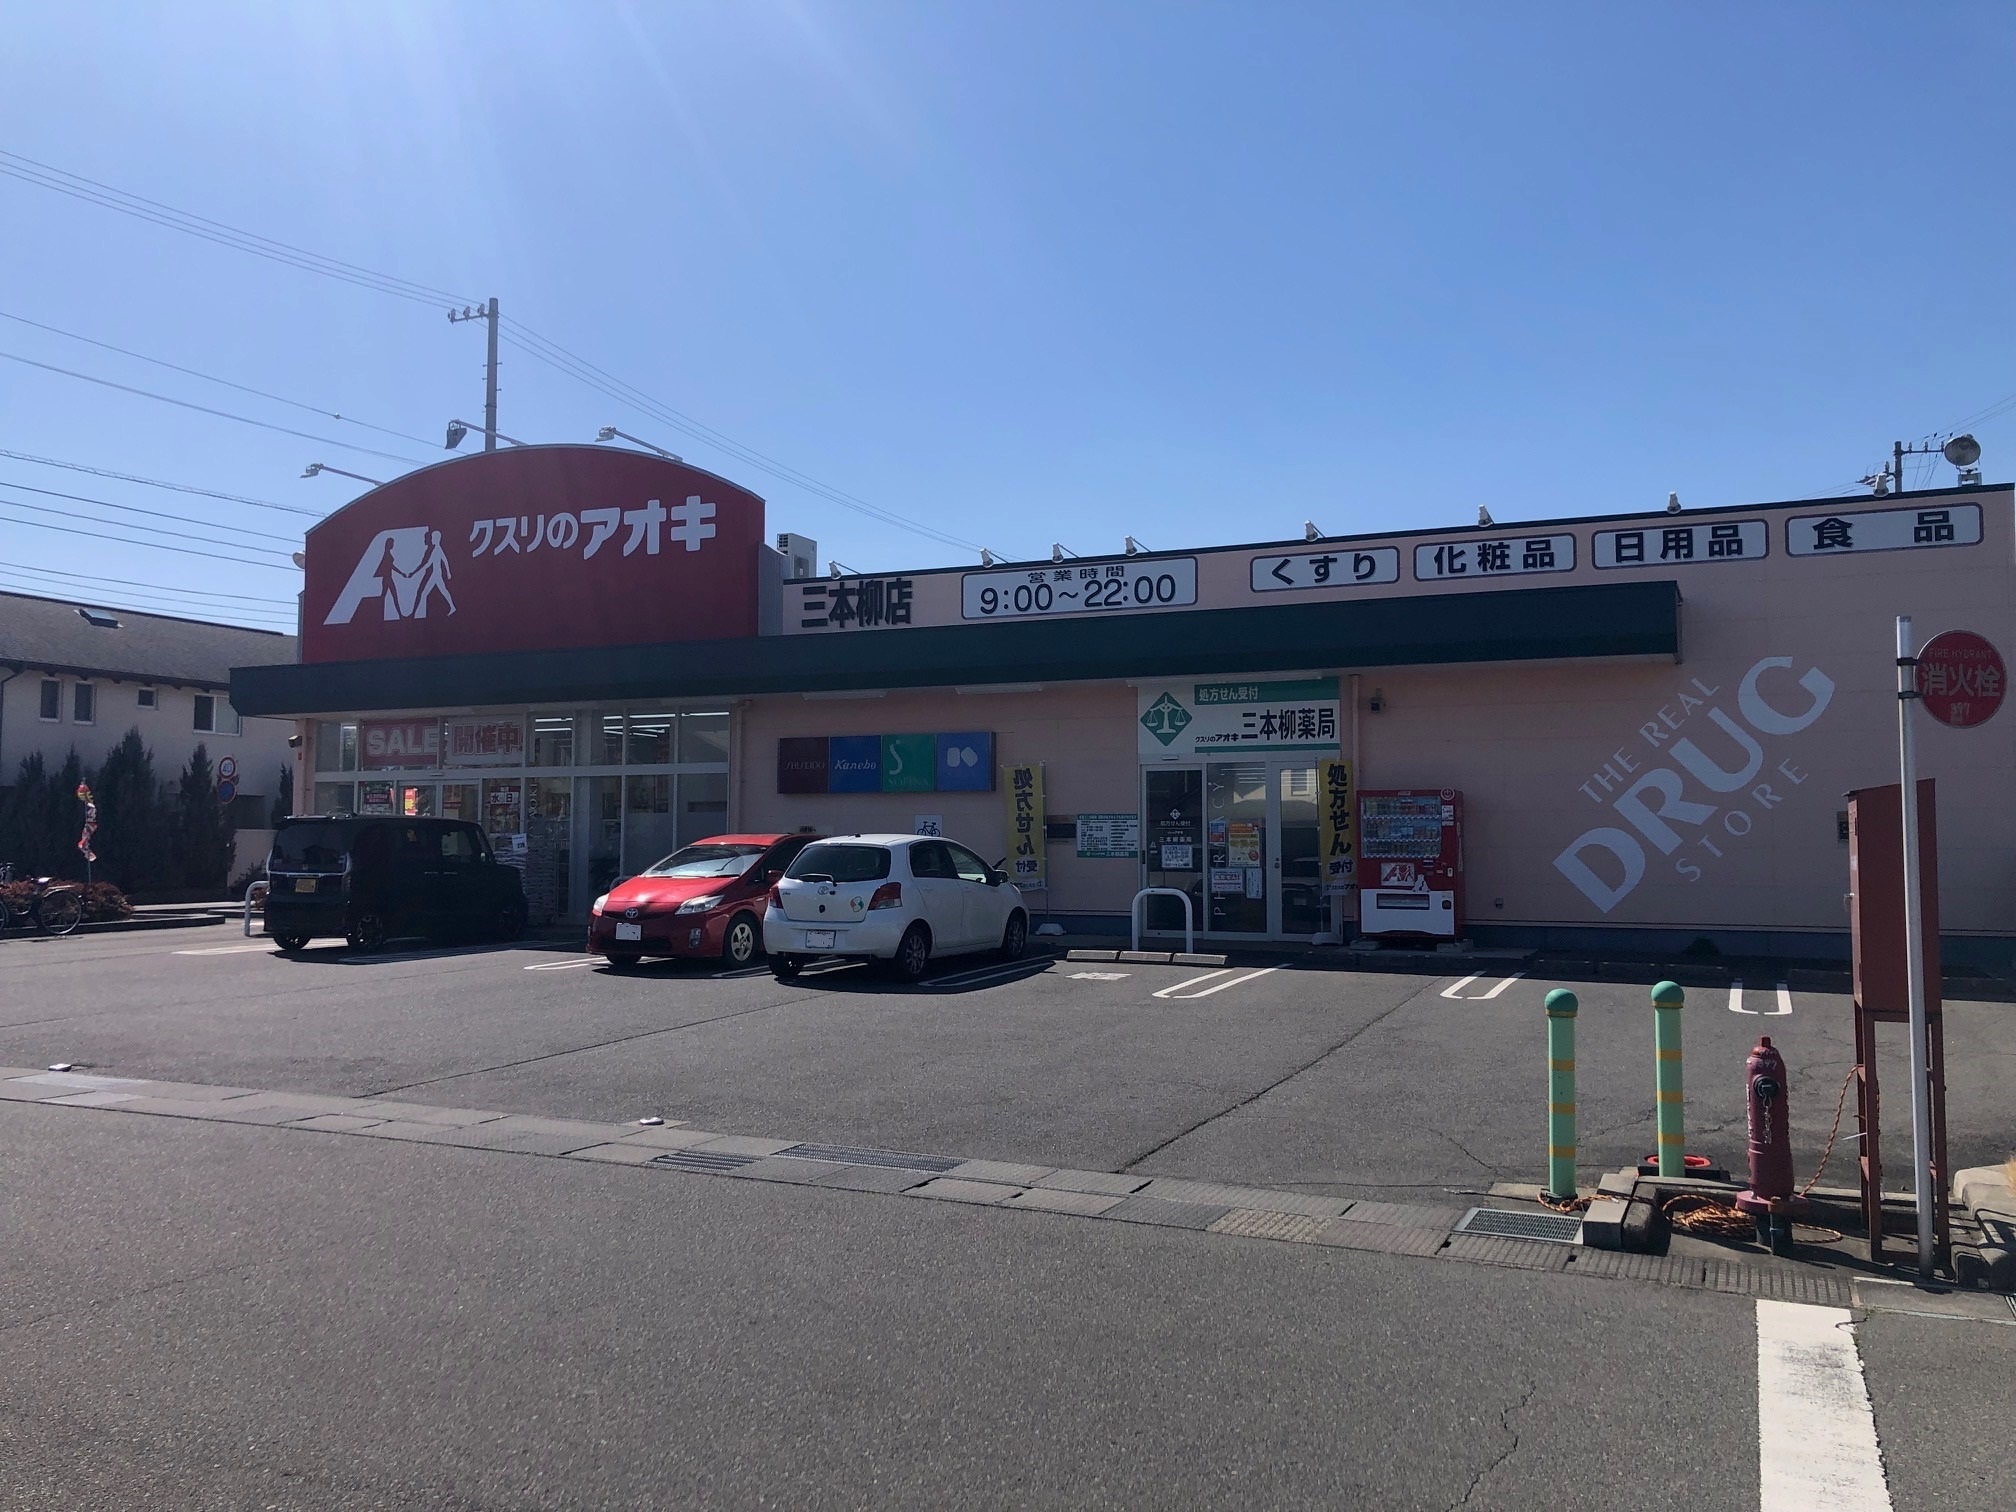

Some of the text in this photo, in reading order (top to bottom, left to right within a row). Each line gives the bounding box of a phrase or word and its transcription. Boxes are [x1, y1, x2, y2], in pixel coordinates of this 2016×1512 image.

[469, 495, 717, 560] クスリのアオキ
[1614, 523, 1745, 563] 日用品
[1810, 510, 1956, 548] 食品
[1270, 552, 1377, 585] くすり
[1433, 532, 1557, 576] 化粧品
[1028, 565, 1126, 584] 営業時間
[801, 578, 913, 629] 三本柳店
[1928, 647, 1949, 659] FIRE
[1198, 686, 1259, 702] 処方せん受付
[1921, 662, 2001, 698] 消火栓
[366, 727, 438, 756] SALE
[1195, 708, 1335, 743] クスリのアオキ 三本柳薬局
[1578, 677, 1720, 804] THE REAL
[834, 759, 877, 770] Kanebo
[1552, 656, 1836, 915] DRUG
[1327, 764, 1352, 856] 処方せん
[1675, 758, 1809, 882] STORE
[1329, 859, 1354, 875] 受付
